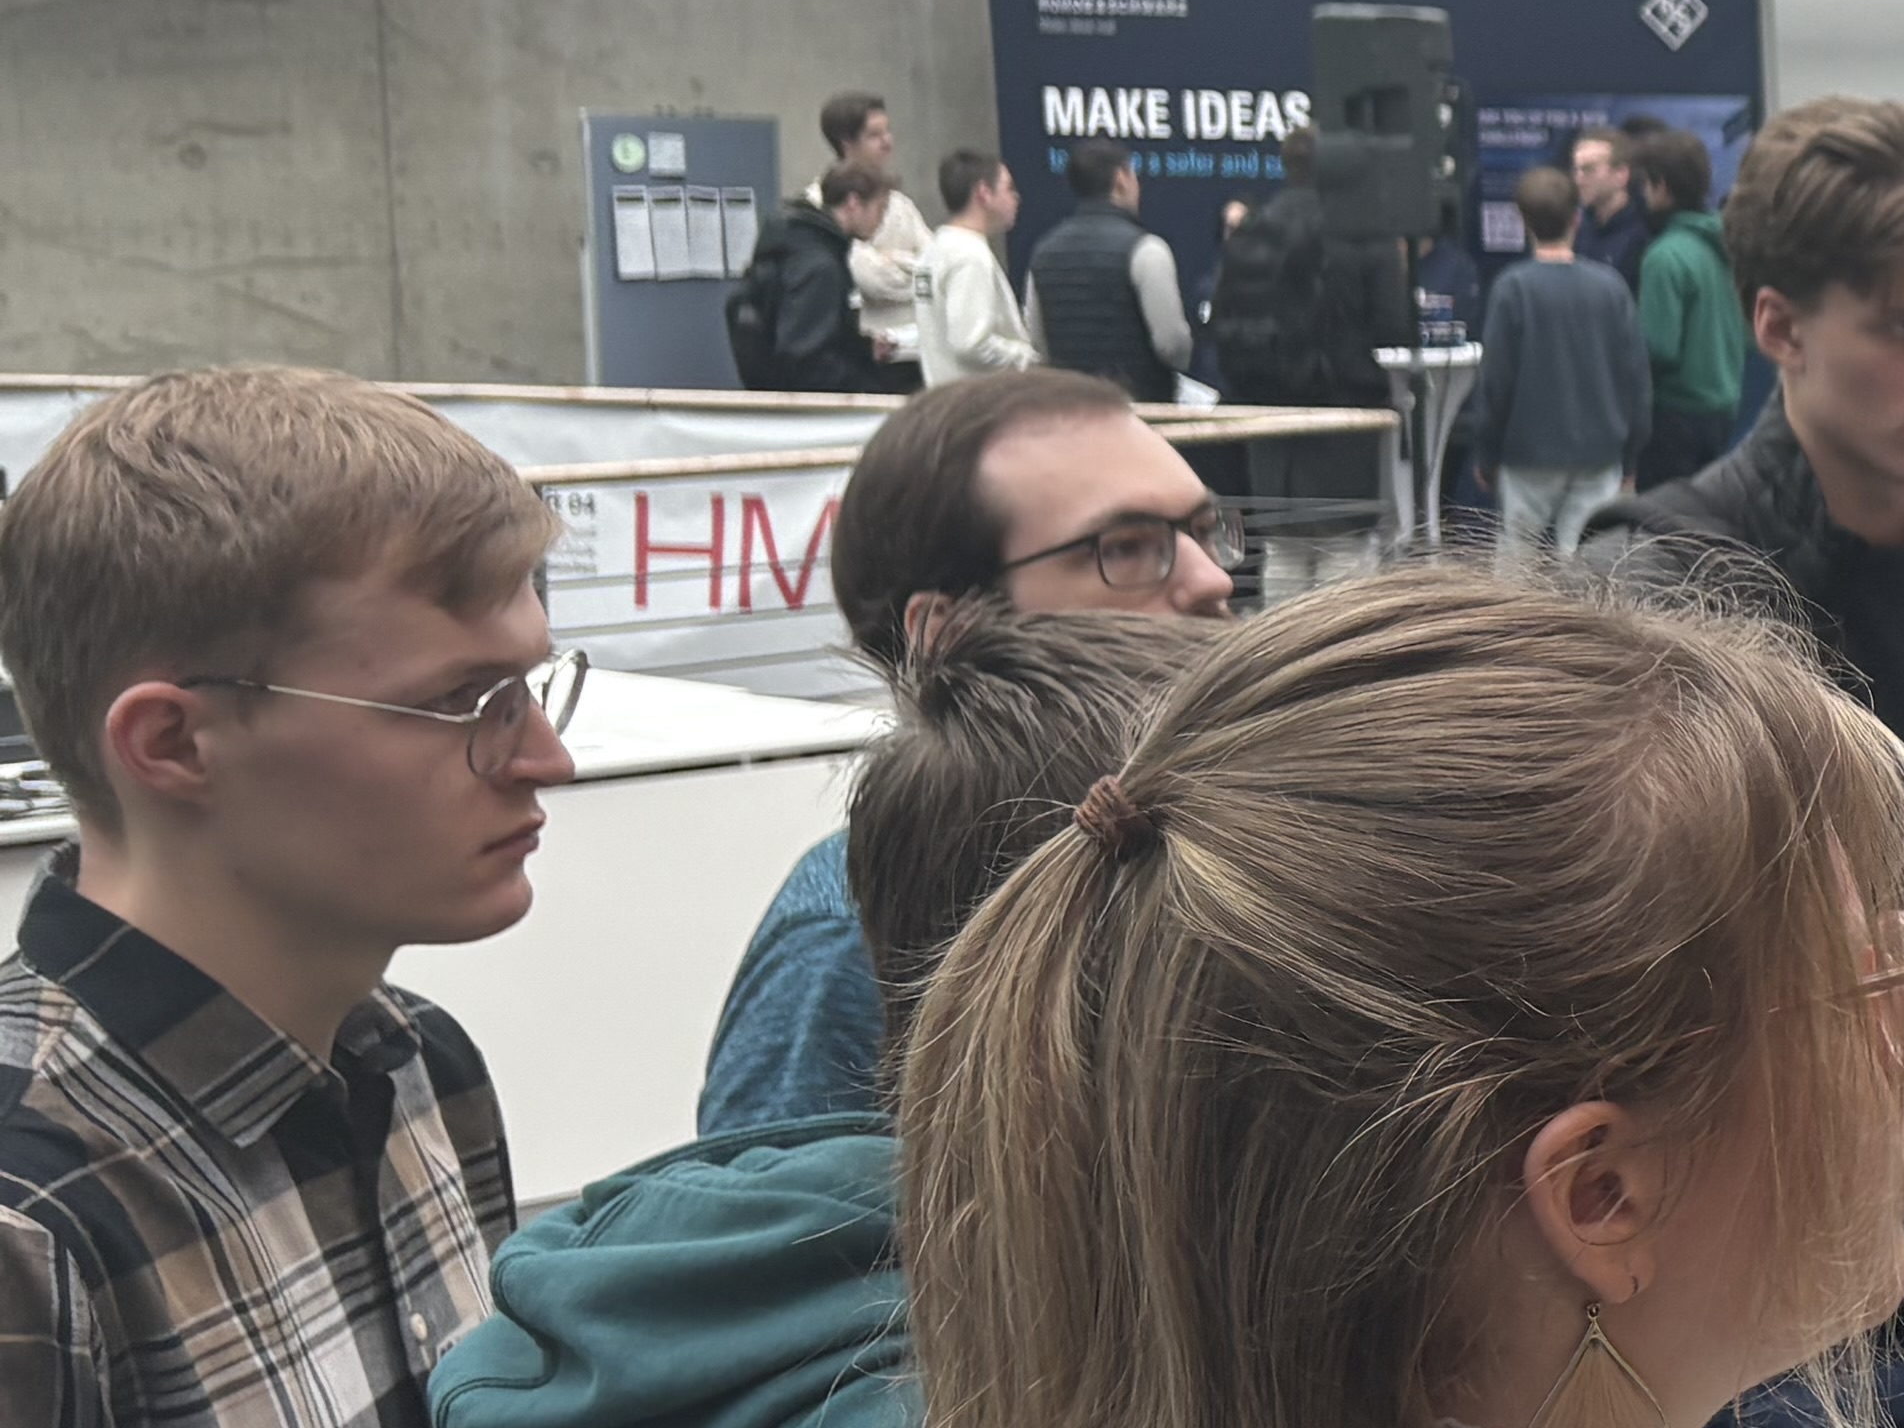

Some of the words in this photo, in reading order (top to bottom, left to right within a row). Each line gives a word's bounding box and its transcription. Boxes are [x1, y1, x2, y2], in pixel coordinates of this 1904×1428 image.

[1042, 85, 1172, 140] MAKE
[1181, 88, 1311, 141] IDEAS
[1165, 148, 1214, 177] safer
[1221, 150, 1260, 179] and
[634, 492, 840, 614] HM
